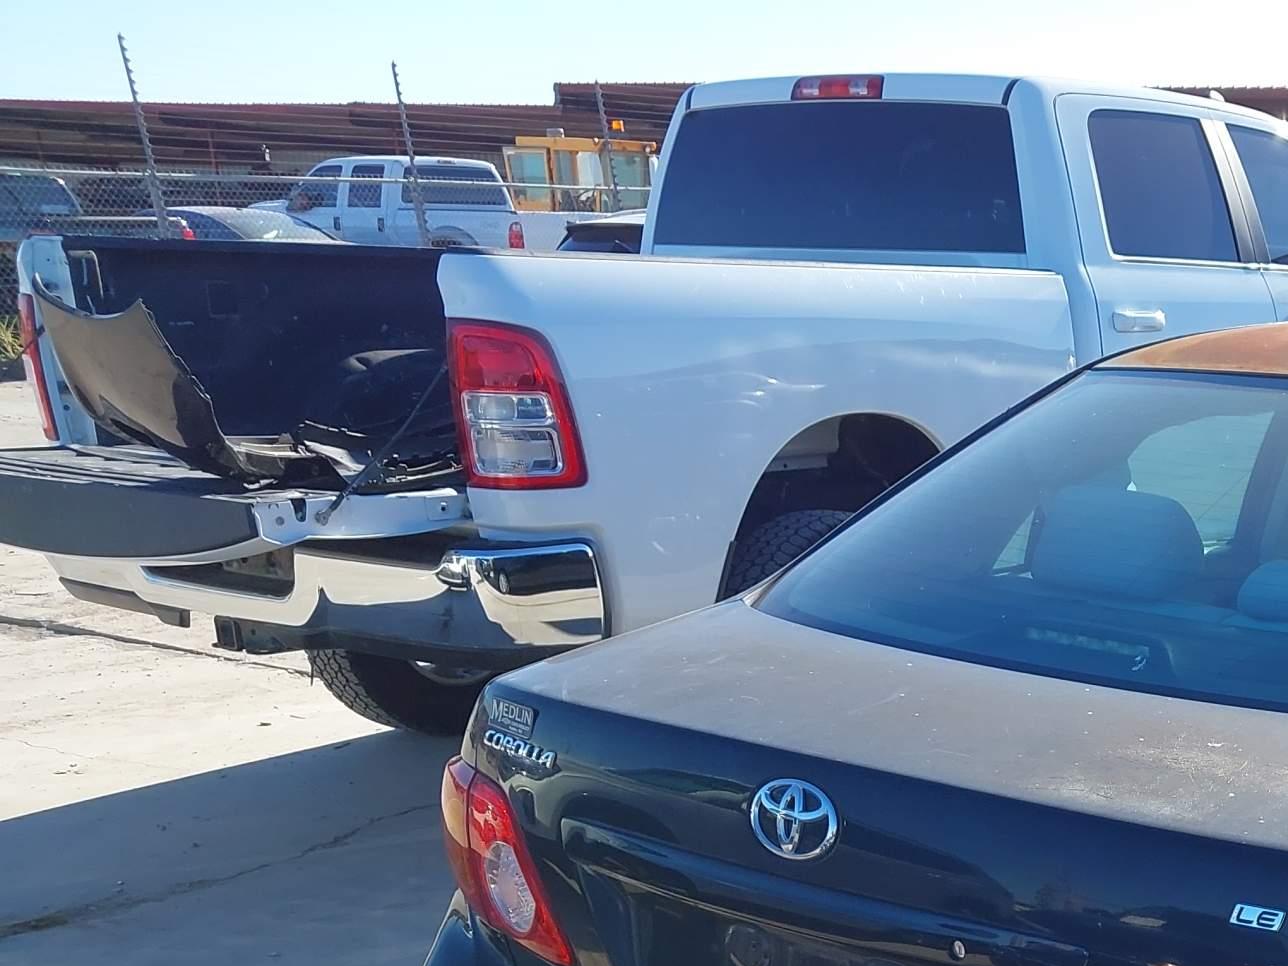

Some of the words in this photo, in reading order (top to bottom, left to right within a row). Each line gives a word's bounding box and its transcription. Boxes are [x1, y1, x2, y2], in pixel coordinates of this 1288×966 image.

[491, 699, 532, 725] MEDLIN
[484, 730, 556, 768] COROLLA
[1234, 905, 1282, 930] LE
